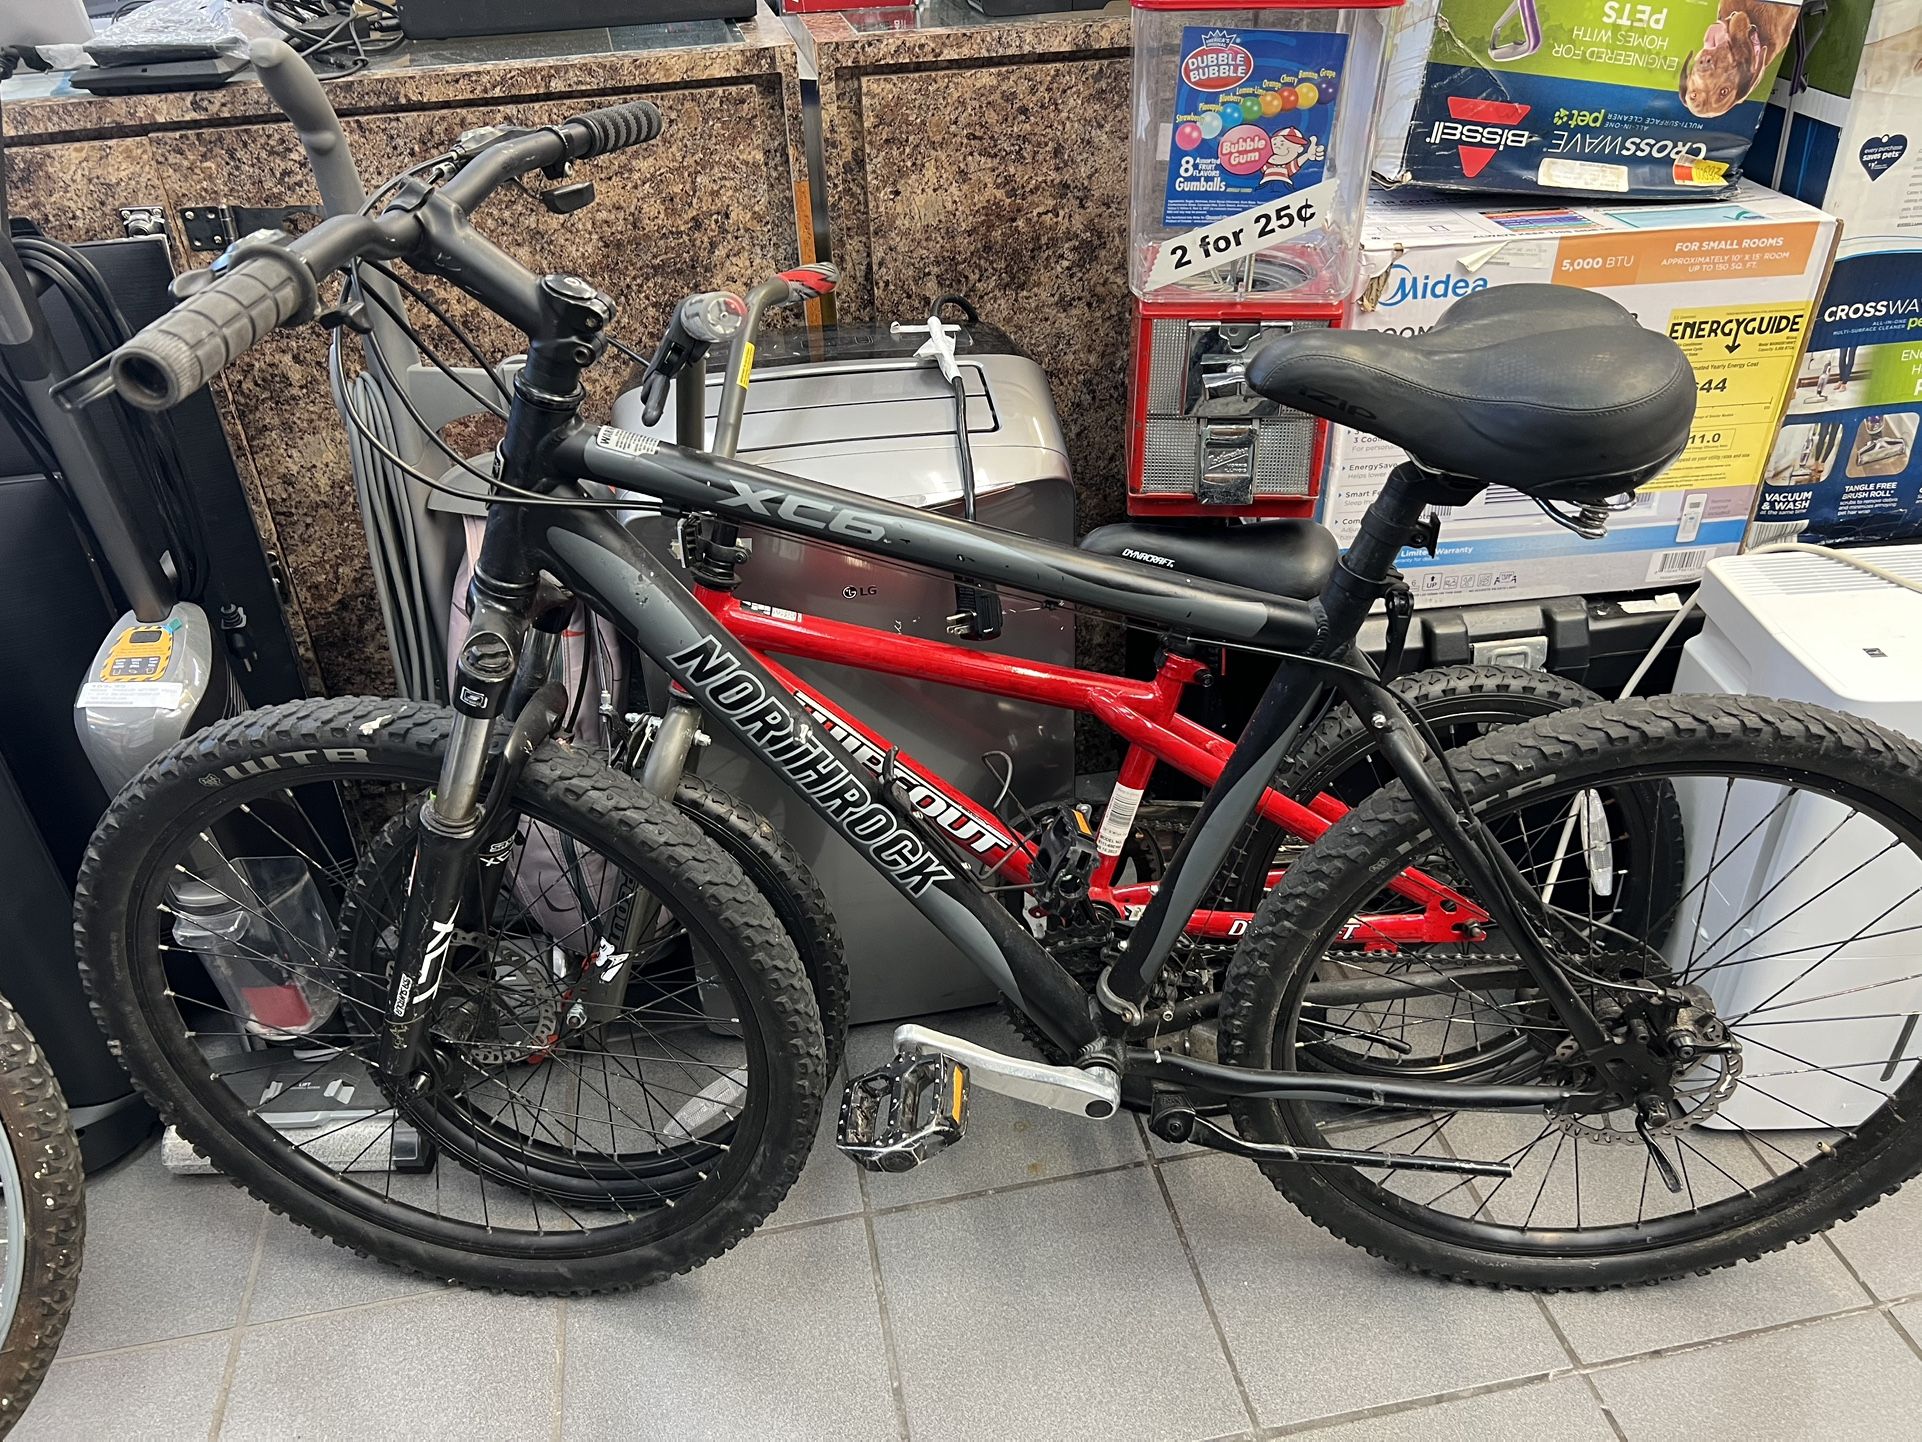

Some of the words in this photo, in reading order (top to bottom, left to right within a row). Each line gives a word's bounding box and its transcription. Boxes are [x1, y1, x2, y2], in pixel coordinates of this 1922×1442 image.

[1602, 0, 1668, 29] PETS
[1572, 26, 1612, 43] WITH
[1616, 31, 1669, 50] HOMES
[1552, 42, 1583, 60] FOR
[1586, 46, 1679, 71] ENGINEERED
[1188, 53, 1245, 70] DUBBLE
[1190, 65, 1247, 82] BUBBLE
[1280, 73, 1299, 86] Cherry
[1262, 79, 1282, 90] Orange
[1569, 109, 1605, 129] pet
[1607, 112, 1643, 123] CLEANER
[1645, 117, 1703, 129] MULTI-SURFACE
[1604, 121, 1649, 131] ALL-IN-ONE
[1222, 137, 1266, 154] Bubble
[1547, 131, 1707, 161] CROSSWAVE
[1230, 152, 1259, 165] Gum
[1862, 153, 1881, 161] saves
[1180, 156, 1194, 177] 8
[1175, 177, 1226, 193] Gumballs
[1170, 245, 1192, 270] 2
[1198, 228, 1244, 258] for
[1253, 198, 1316, 239] 25¢
[1675, 241, 1700, 252] FOR
[1701, 239, 1739, 251] SMALL
[1742, 237, 1784, 249] ROOMS
[1561, 257, 1602, 271] 5,000
[1605, 255, 1635, 269] BTU
[1660, 254, 1729, 266] APPROXIMATELY
[1763, 251, 1790, 260] ROOM
[1702, 264, 1713, 272] TO
[1715, 263, 1728, 271] 150
[1824, 298, 1922, 323] CROSSWA
[1669, 314, 1804, 343] ENERGYGUIDE
[1872, 318, 1907, 326] ALL-IN-ONE
[1345, 490, 1369, 498] Smart
[1845, 483, 1875, 492] TANGLE
[1876, 481, 1898, 490] FREE
[1765, 491, 1813, 502] VACUUM
[1842, 491, 1869, 500] BRUSH
[718, 479, 887, 542] XC6
[1761, 502, 1771, 510] &
[1774, 500, 1810, 510] WASH
[1122, 548, 1175, 568] DYNACRAFT
[1400, 549, 1429, 557] Limite
[1434, 546, 1473, 555] Warranty
[859, 585, 878, 596] LG
[222, 747, 371, 780] WTB
[666, 633, 955, 899] NORTHROCK
